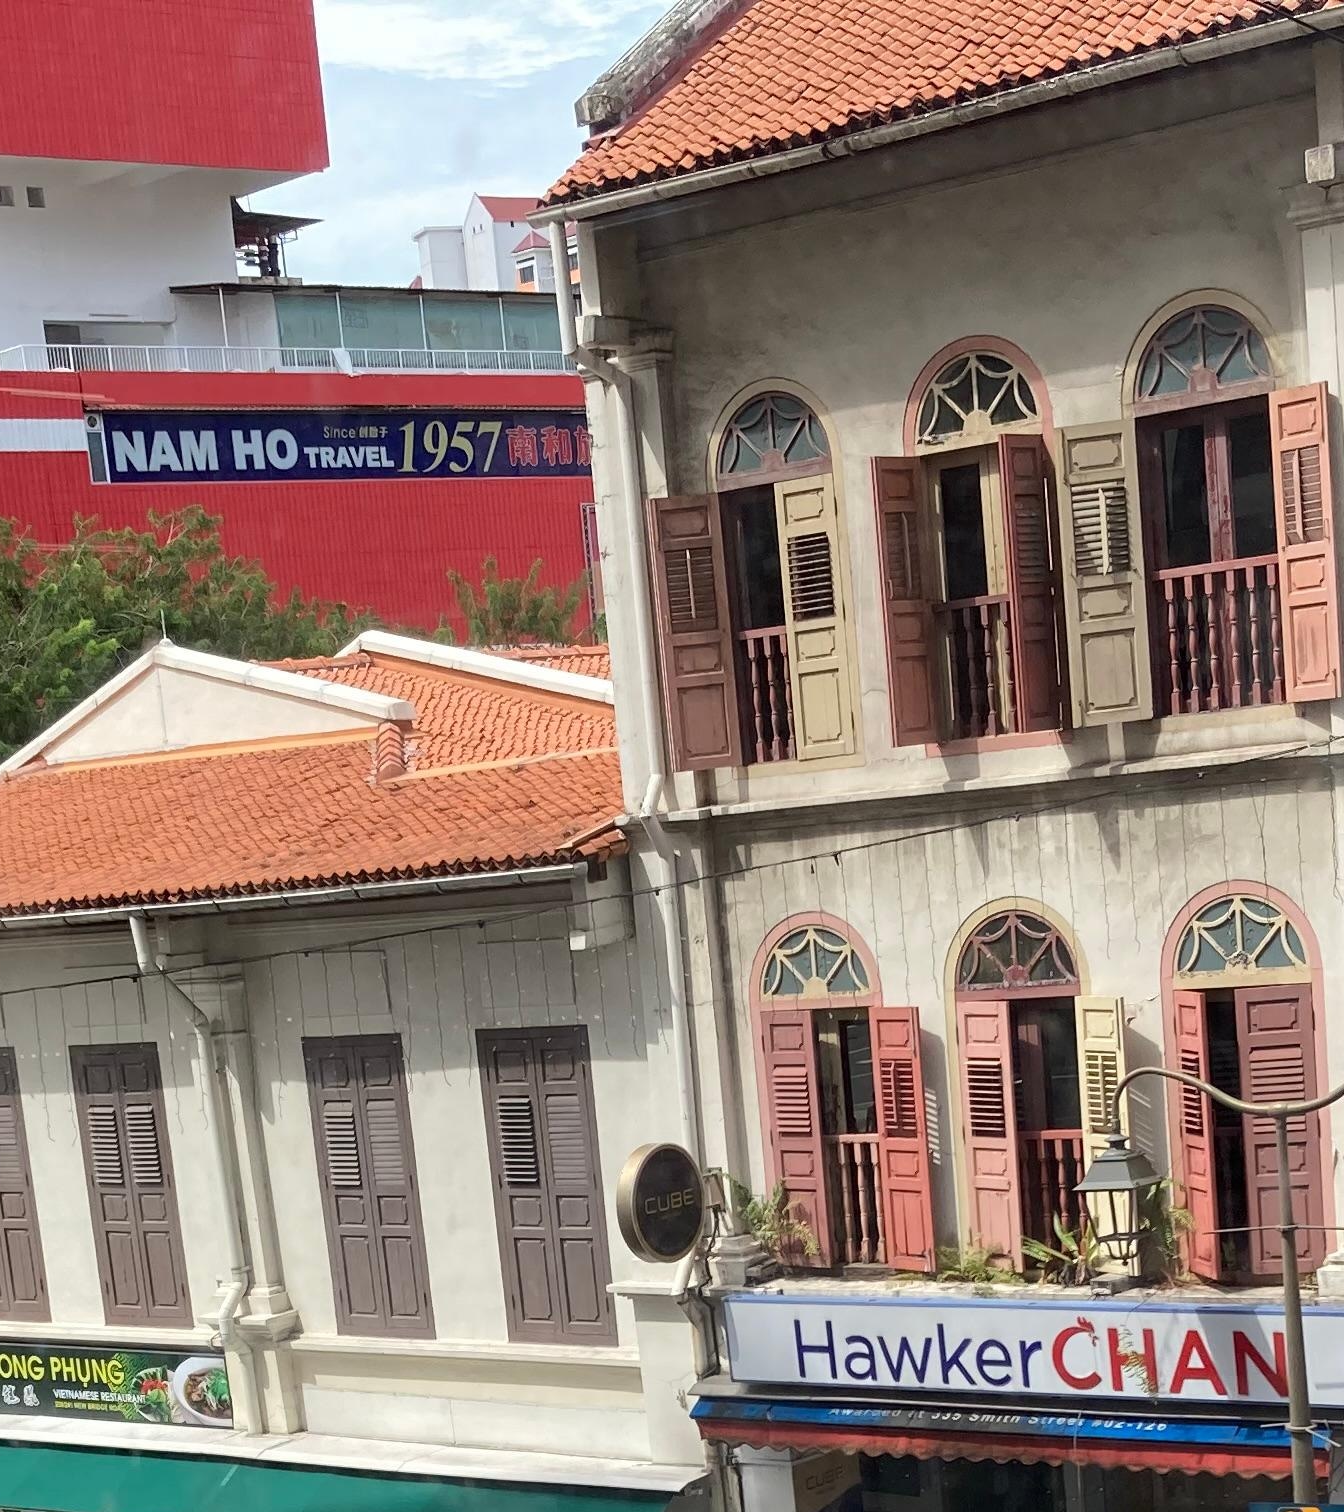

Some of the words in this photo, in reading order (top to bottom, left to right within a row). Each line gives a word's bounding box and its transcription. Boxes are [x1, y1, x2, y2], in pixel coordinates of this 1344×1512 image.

[323, 425, 356, 439] Since
[397, 420, 503, 473] 1957
[111, 430, 219, 472] NAM
[231, 428, 299, 470] HO
[303, 445, 395, 469] TRAVEL
[644, 1188, 695, 1214] CUBE
[49, 1356, 125, 1388] PHỤNG
[52, 1388, 100, 1401] VIETNAMESE
[100, 1391, 146, 1405] RESTAURANT
